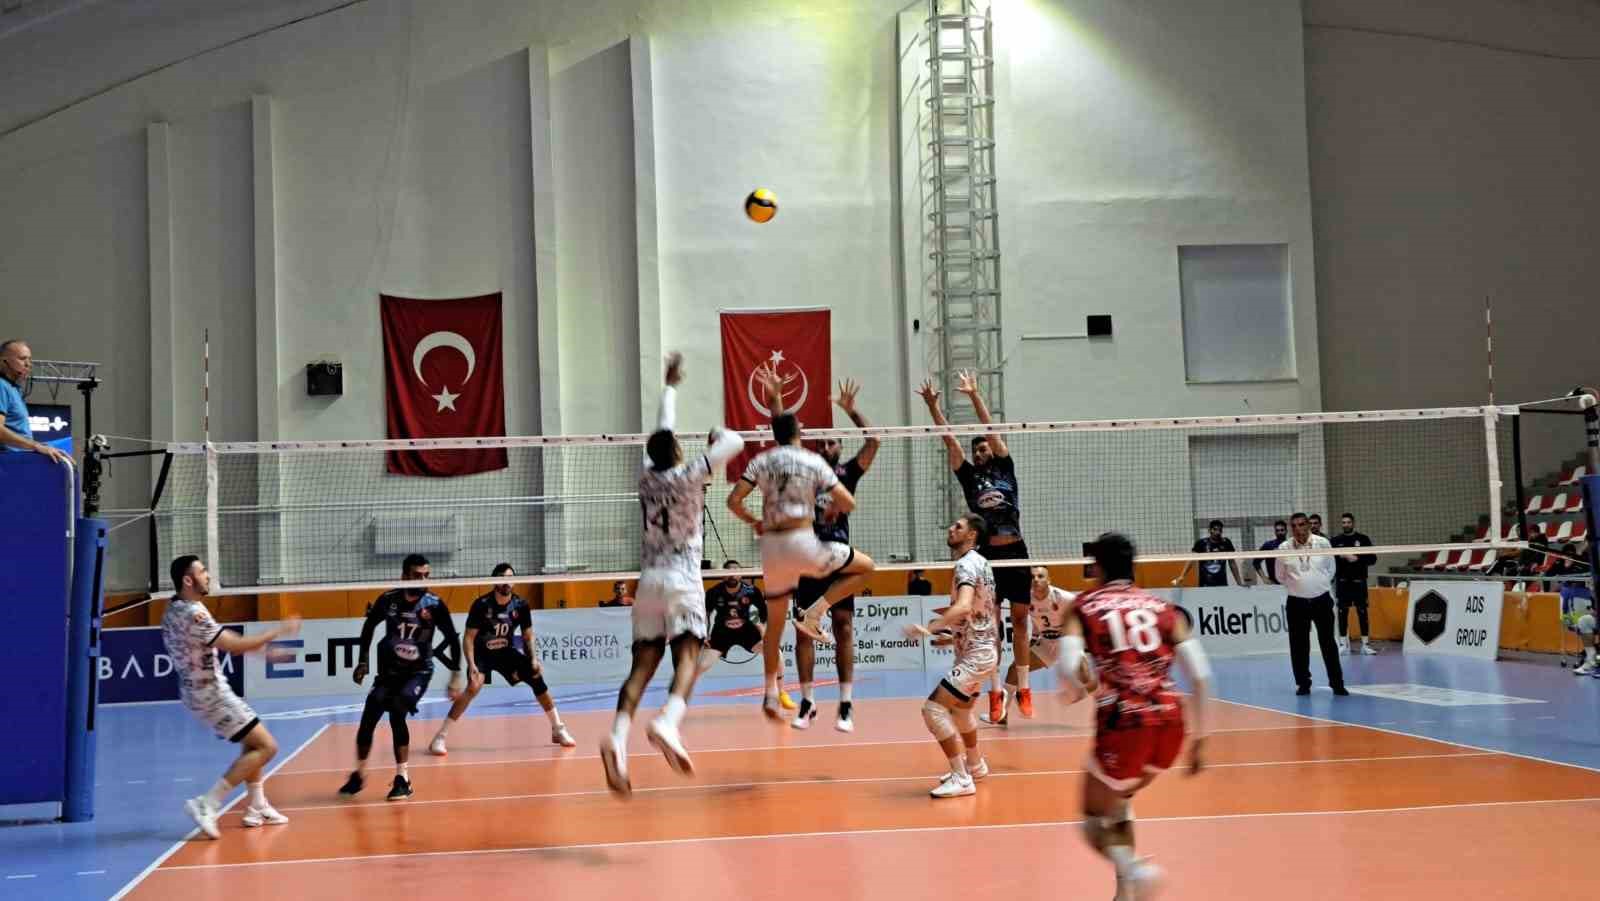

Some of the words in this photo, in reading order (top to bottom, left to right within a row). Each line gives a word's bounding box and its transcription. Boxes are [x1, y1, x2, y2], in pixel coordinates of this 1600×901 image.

[867, 604, 908, 619] Diyarı
[1465, 596, 1485, 613] ADS
[1198, 605, 1287, 635] kilerhol
[397, 622, 418, 640] 17
[494, 623, 509, 637] 10
[1099, 608, 1163, 653] 18
[1456, 628, 1487, 646] GROUP
[880, 639, 919, 649] Karadut
